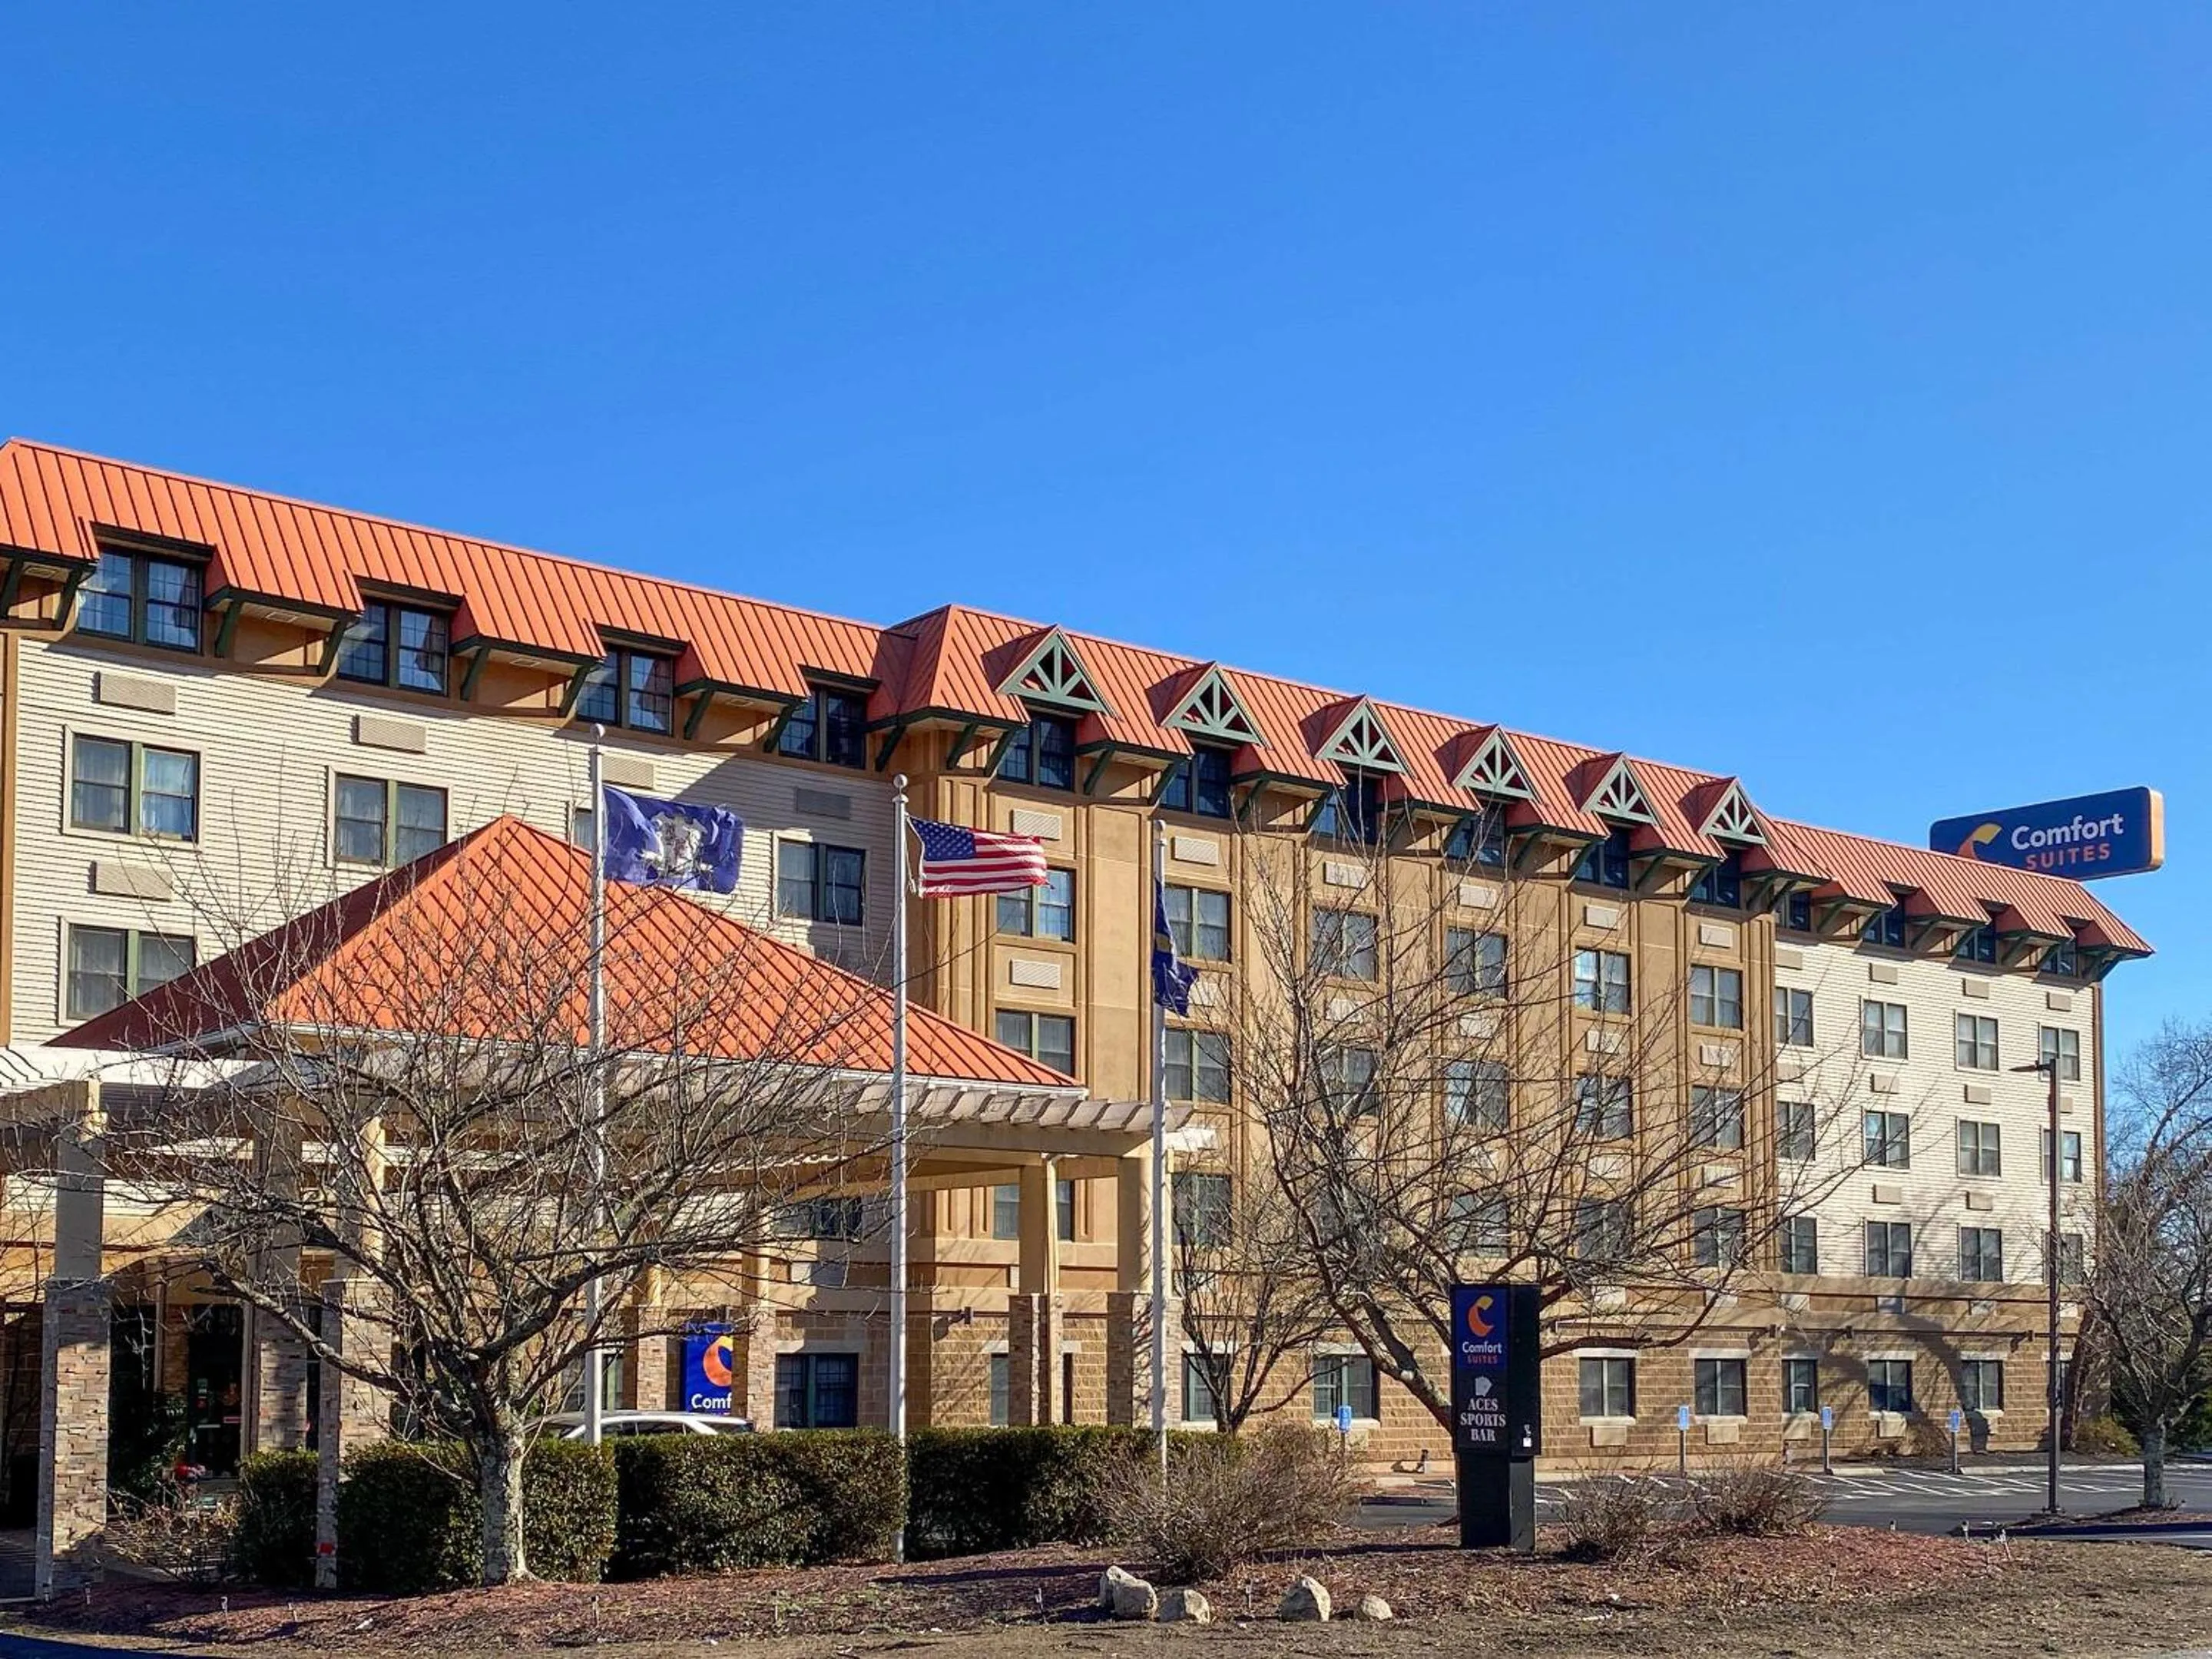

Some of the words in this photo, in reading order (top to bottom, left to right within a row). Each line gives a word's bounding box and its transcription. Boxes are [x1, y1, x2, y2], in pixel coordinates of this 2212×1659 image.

[2011, 813, 2124, 850] Comfort
[2025, 843, 2111, 871] SUITES
[1462, 1341, 1502, 1354] Comfort
[1467, 1355, 1498, 1364] SUITES
[691, 1392, 732, 1409] Comf
[1468, 1398, 1498, 1411] ACES
[1460, 1412, 1506, 1427] SPORTS
[1471, 1428, 1496, 1442] BAR
